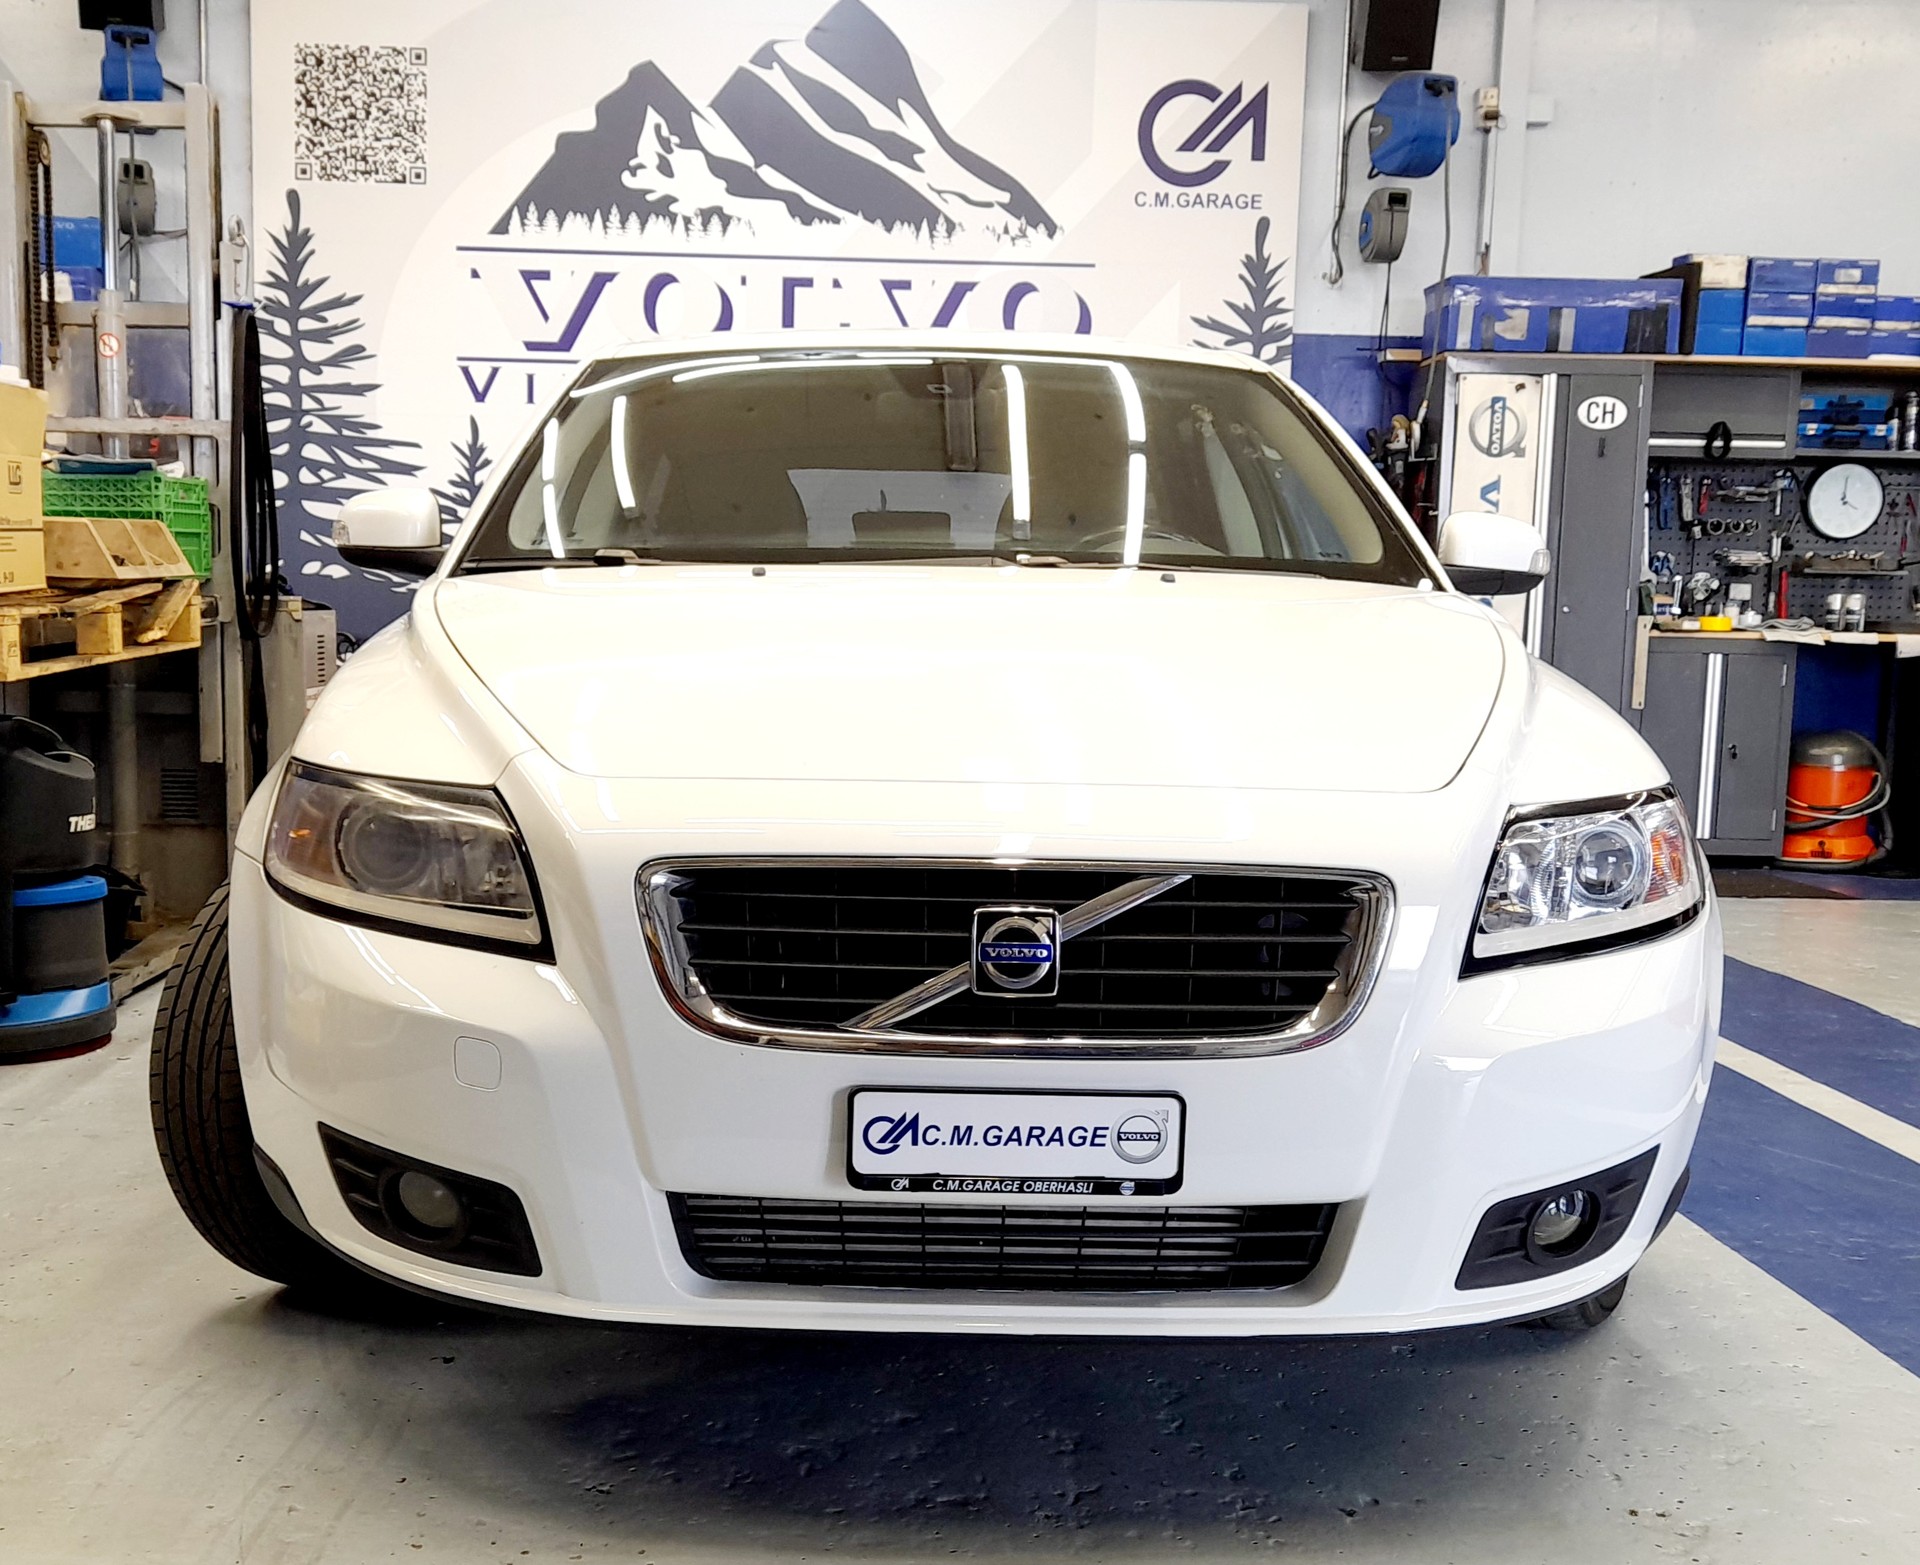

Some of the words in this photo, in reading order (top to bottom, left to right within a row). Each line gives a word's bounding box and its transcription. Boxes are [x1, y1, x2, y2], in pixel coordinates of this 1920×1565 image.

[1134, 191, 1263, 210] C.M.GARAGE
[1586, 401, 1616, 424] CH
[1491, 398, 1504, 454] VOLVO
[985, 948, 1048, 958] VOLVO
[922, 1124, 1109, 1147] C.M.GARAGE
[1119, 1132, 1159, 1140] VOLVO
[932, 1179, 1021, 1192] C.M.GARAGE
[1023, 1181, 1094, 1194] OBERHASLI
